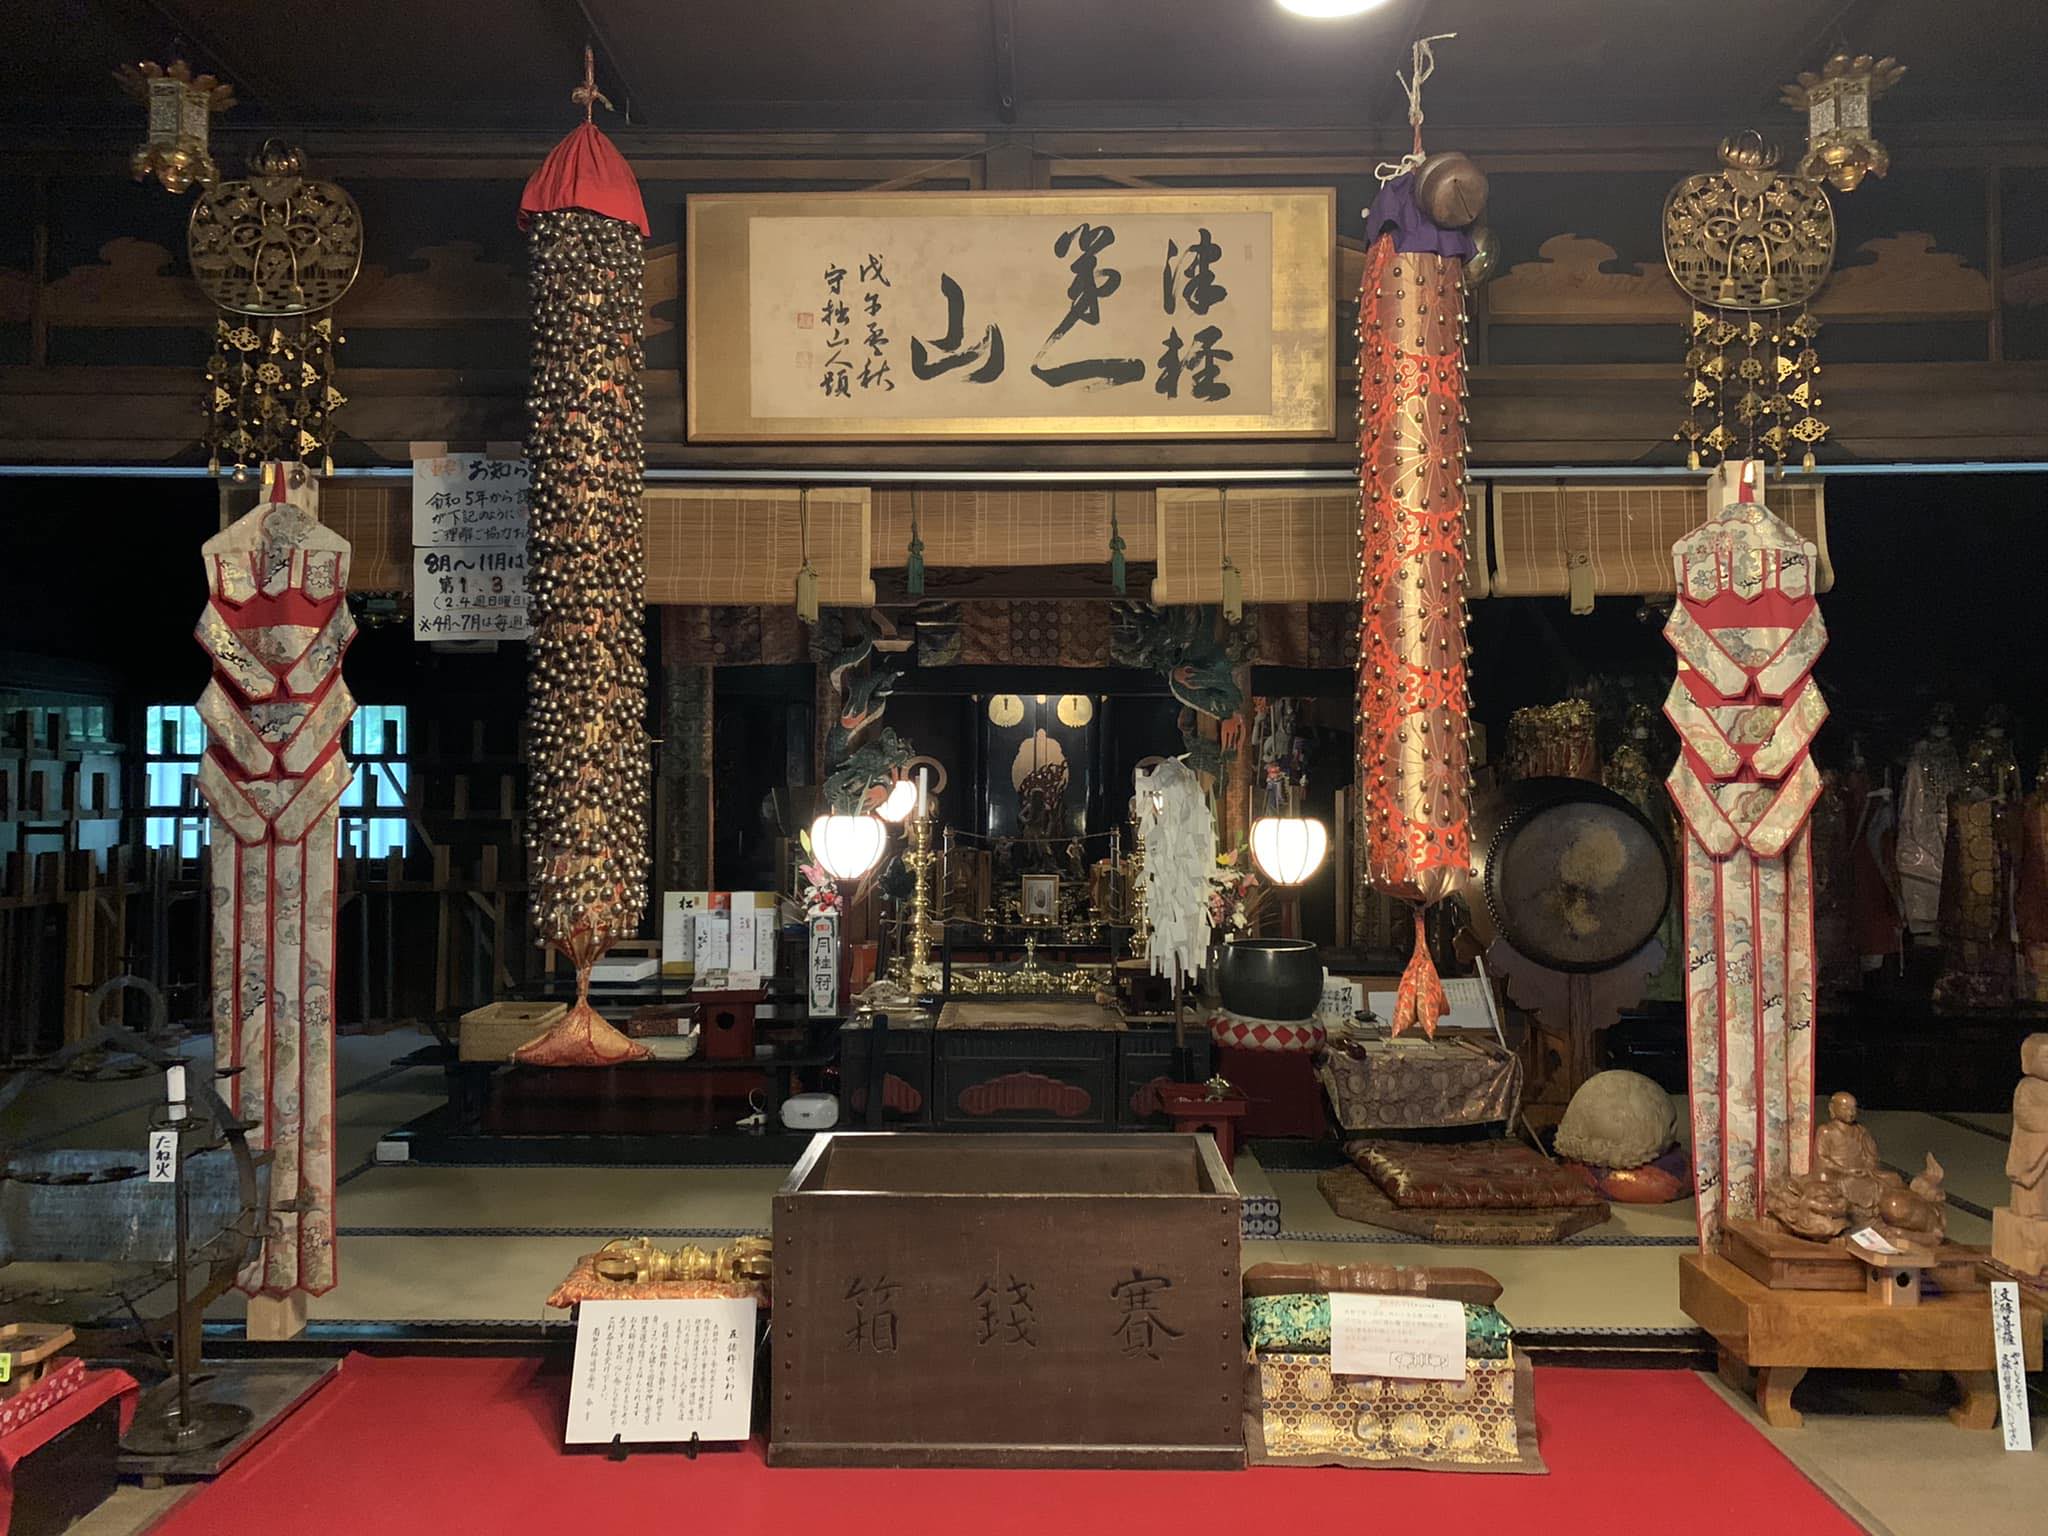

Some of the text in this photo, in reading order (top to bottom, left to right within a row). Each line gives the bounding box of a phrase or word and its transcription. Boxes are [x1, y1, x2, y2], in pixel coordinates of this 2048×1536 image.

[910, 273, 1006, 385] 山
[432, 509, 528, 526] が下記のように
[814, 937, 832, 991] 月桂冠
[155, 1135, 172, 1178] たね火
